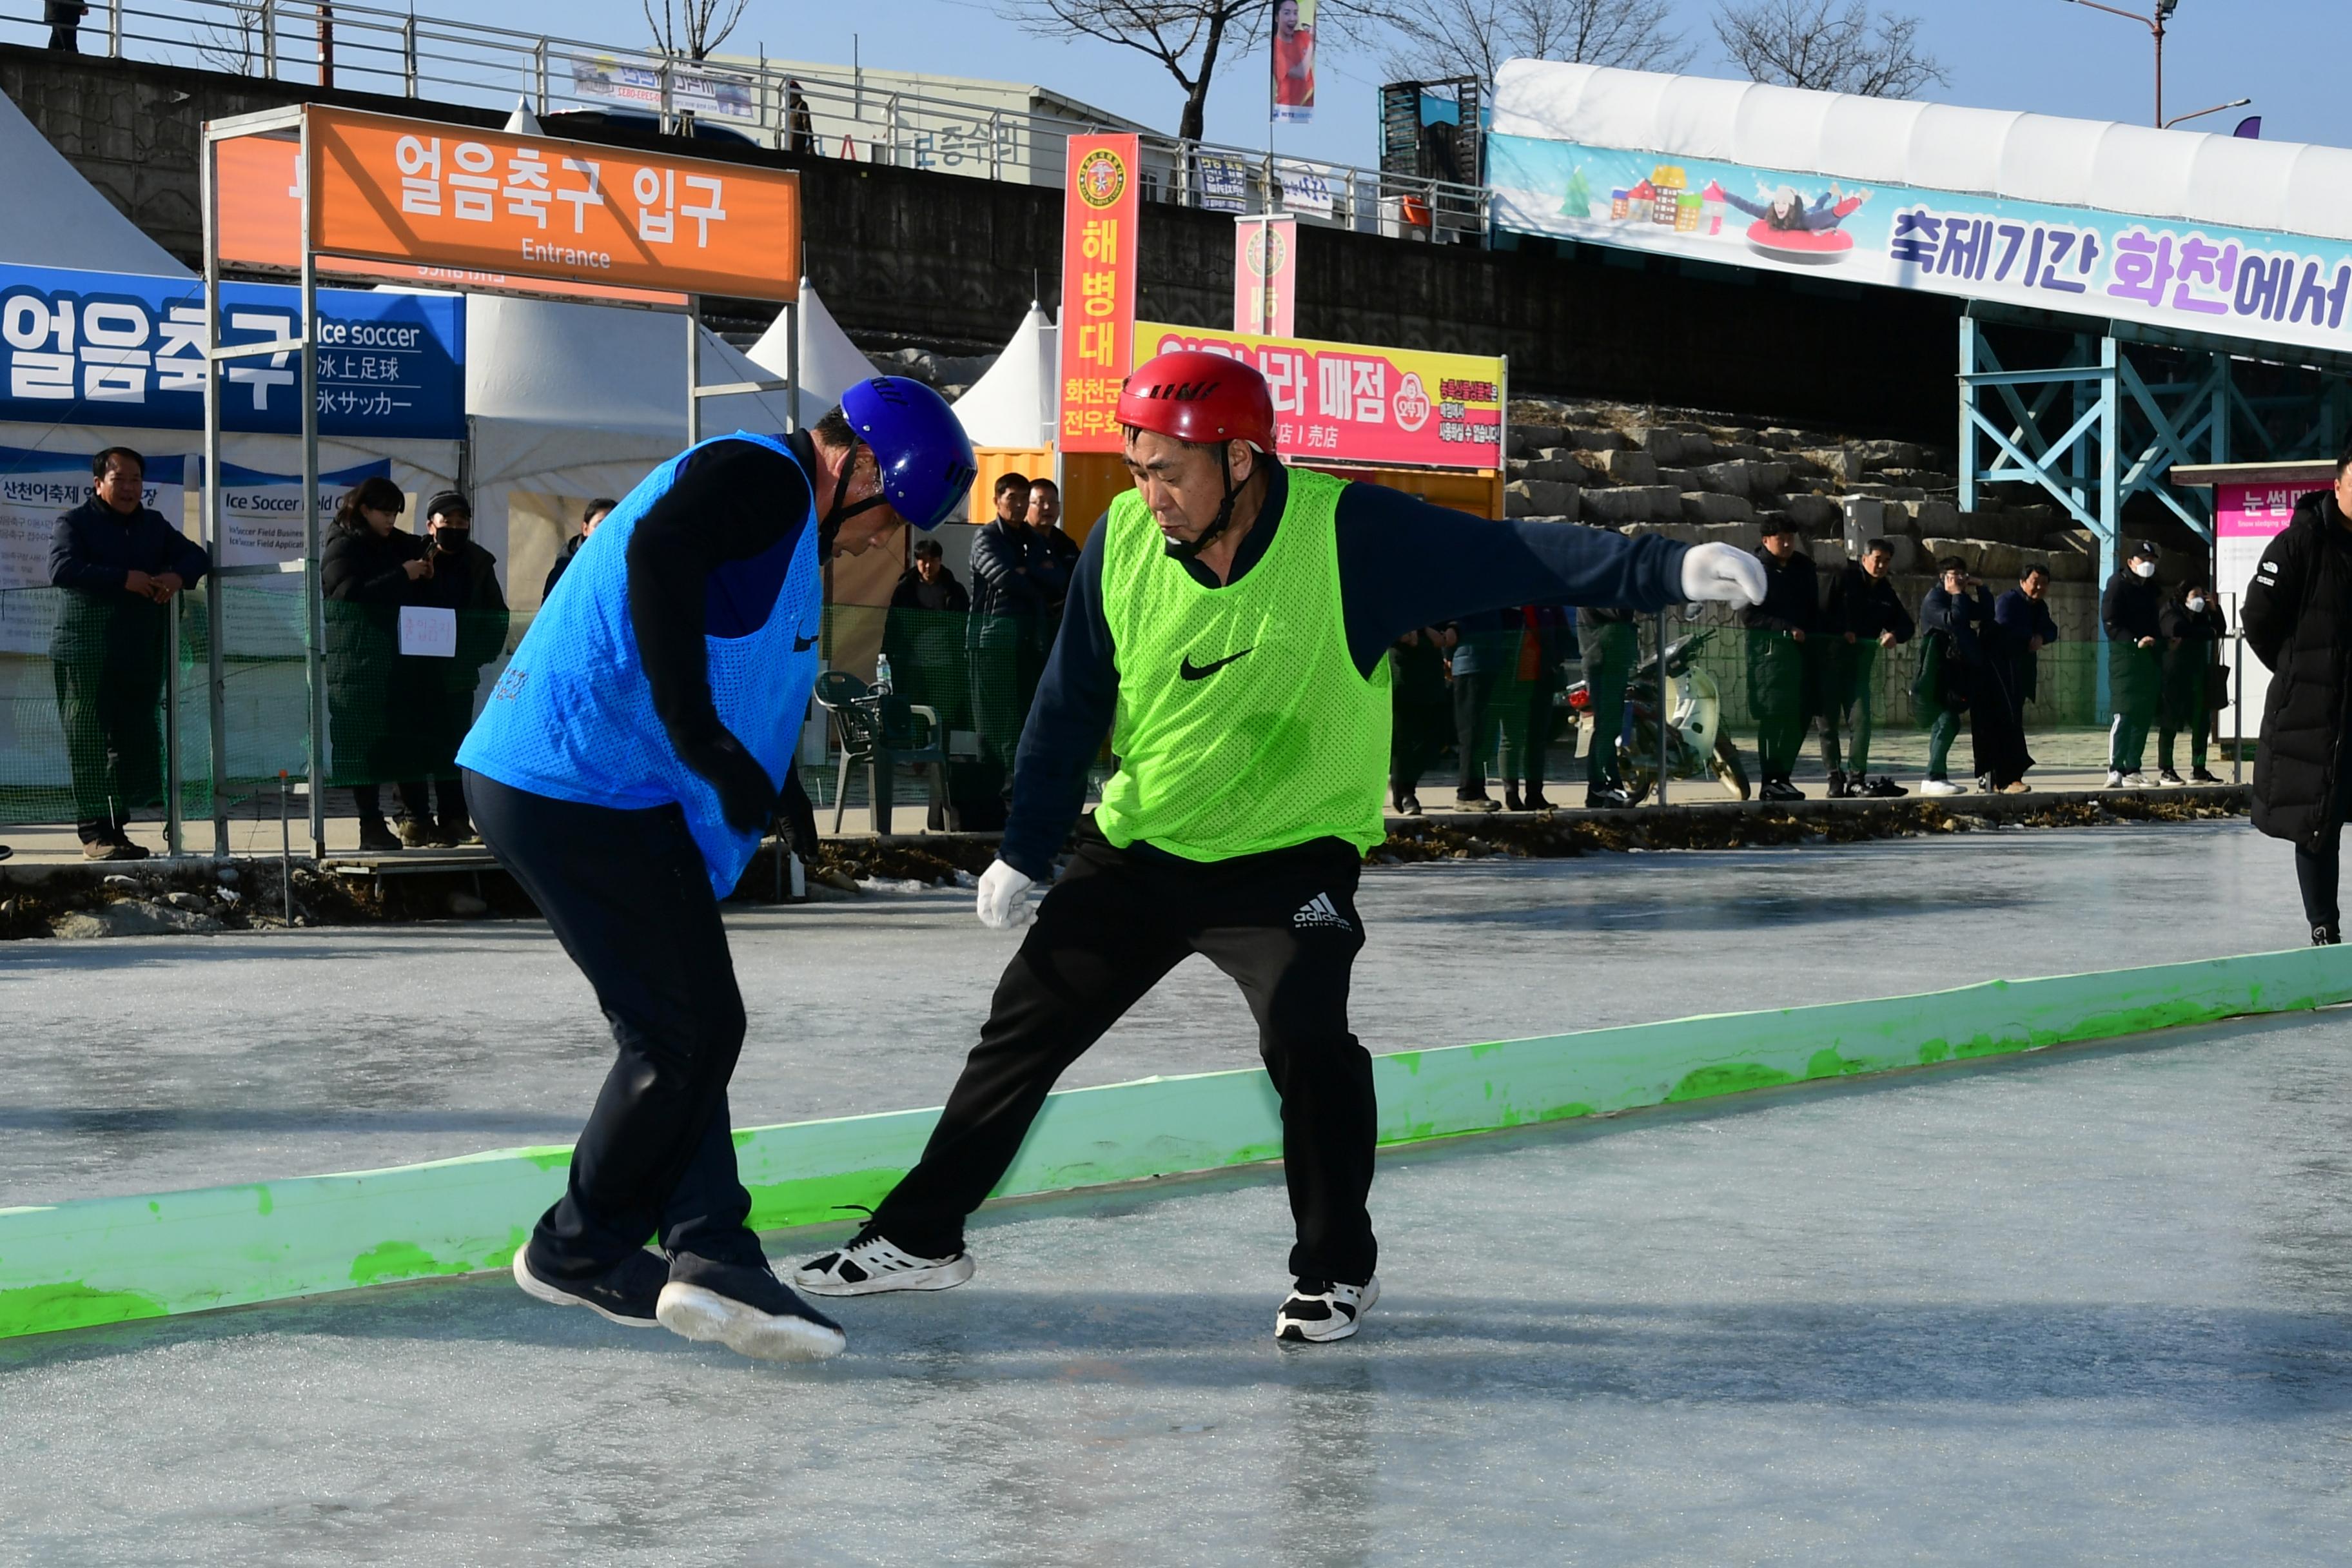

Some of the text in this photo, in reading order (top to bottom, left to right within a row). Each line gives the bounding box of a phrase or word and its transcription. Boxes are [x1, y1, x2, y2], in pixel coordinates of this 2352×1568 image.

[395, 135, 604, 233] 얼음축구
[633, 168, 727, 248] 입구
[522, 237, 611, 270] Entrance
[1890, 210, 2352, 329] 축제기간 화천에서
[1079, 219, 1118, 368] 해병대
[317, 317, 420, 348] Ice soccer
[2, 295, 295, 411] 얼음축구
[317, 354, 399, 381] 冰上足球
[316, 389, 412, 415] 氷サッカー
[1065, 378, 1123, 404] 화천군
[1318, 357, 1385, 424] 매점
[1440, 378, 1498, 402] 농특산물상품권은
[1398, 400, 1425, 418] 오뚜기
[1308, 424, 1339, 449] 売店
[1439, 421, 1464, 442] 사용하실
[1465, 422, 1473, 443] 수
[4, 481, 79, 504] 산천어축제
[226, 493, 248, 509] Ice
[251, 495, 300, 511] Soccer
[257, 527, 276, 536] Field
[257, 538, 274, 547] Field
[1293, 910, 1350, 926] adidas
